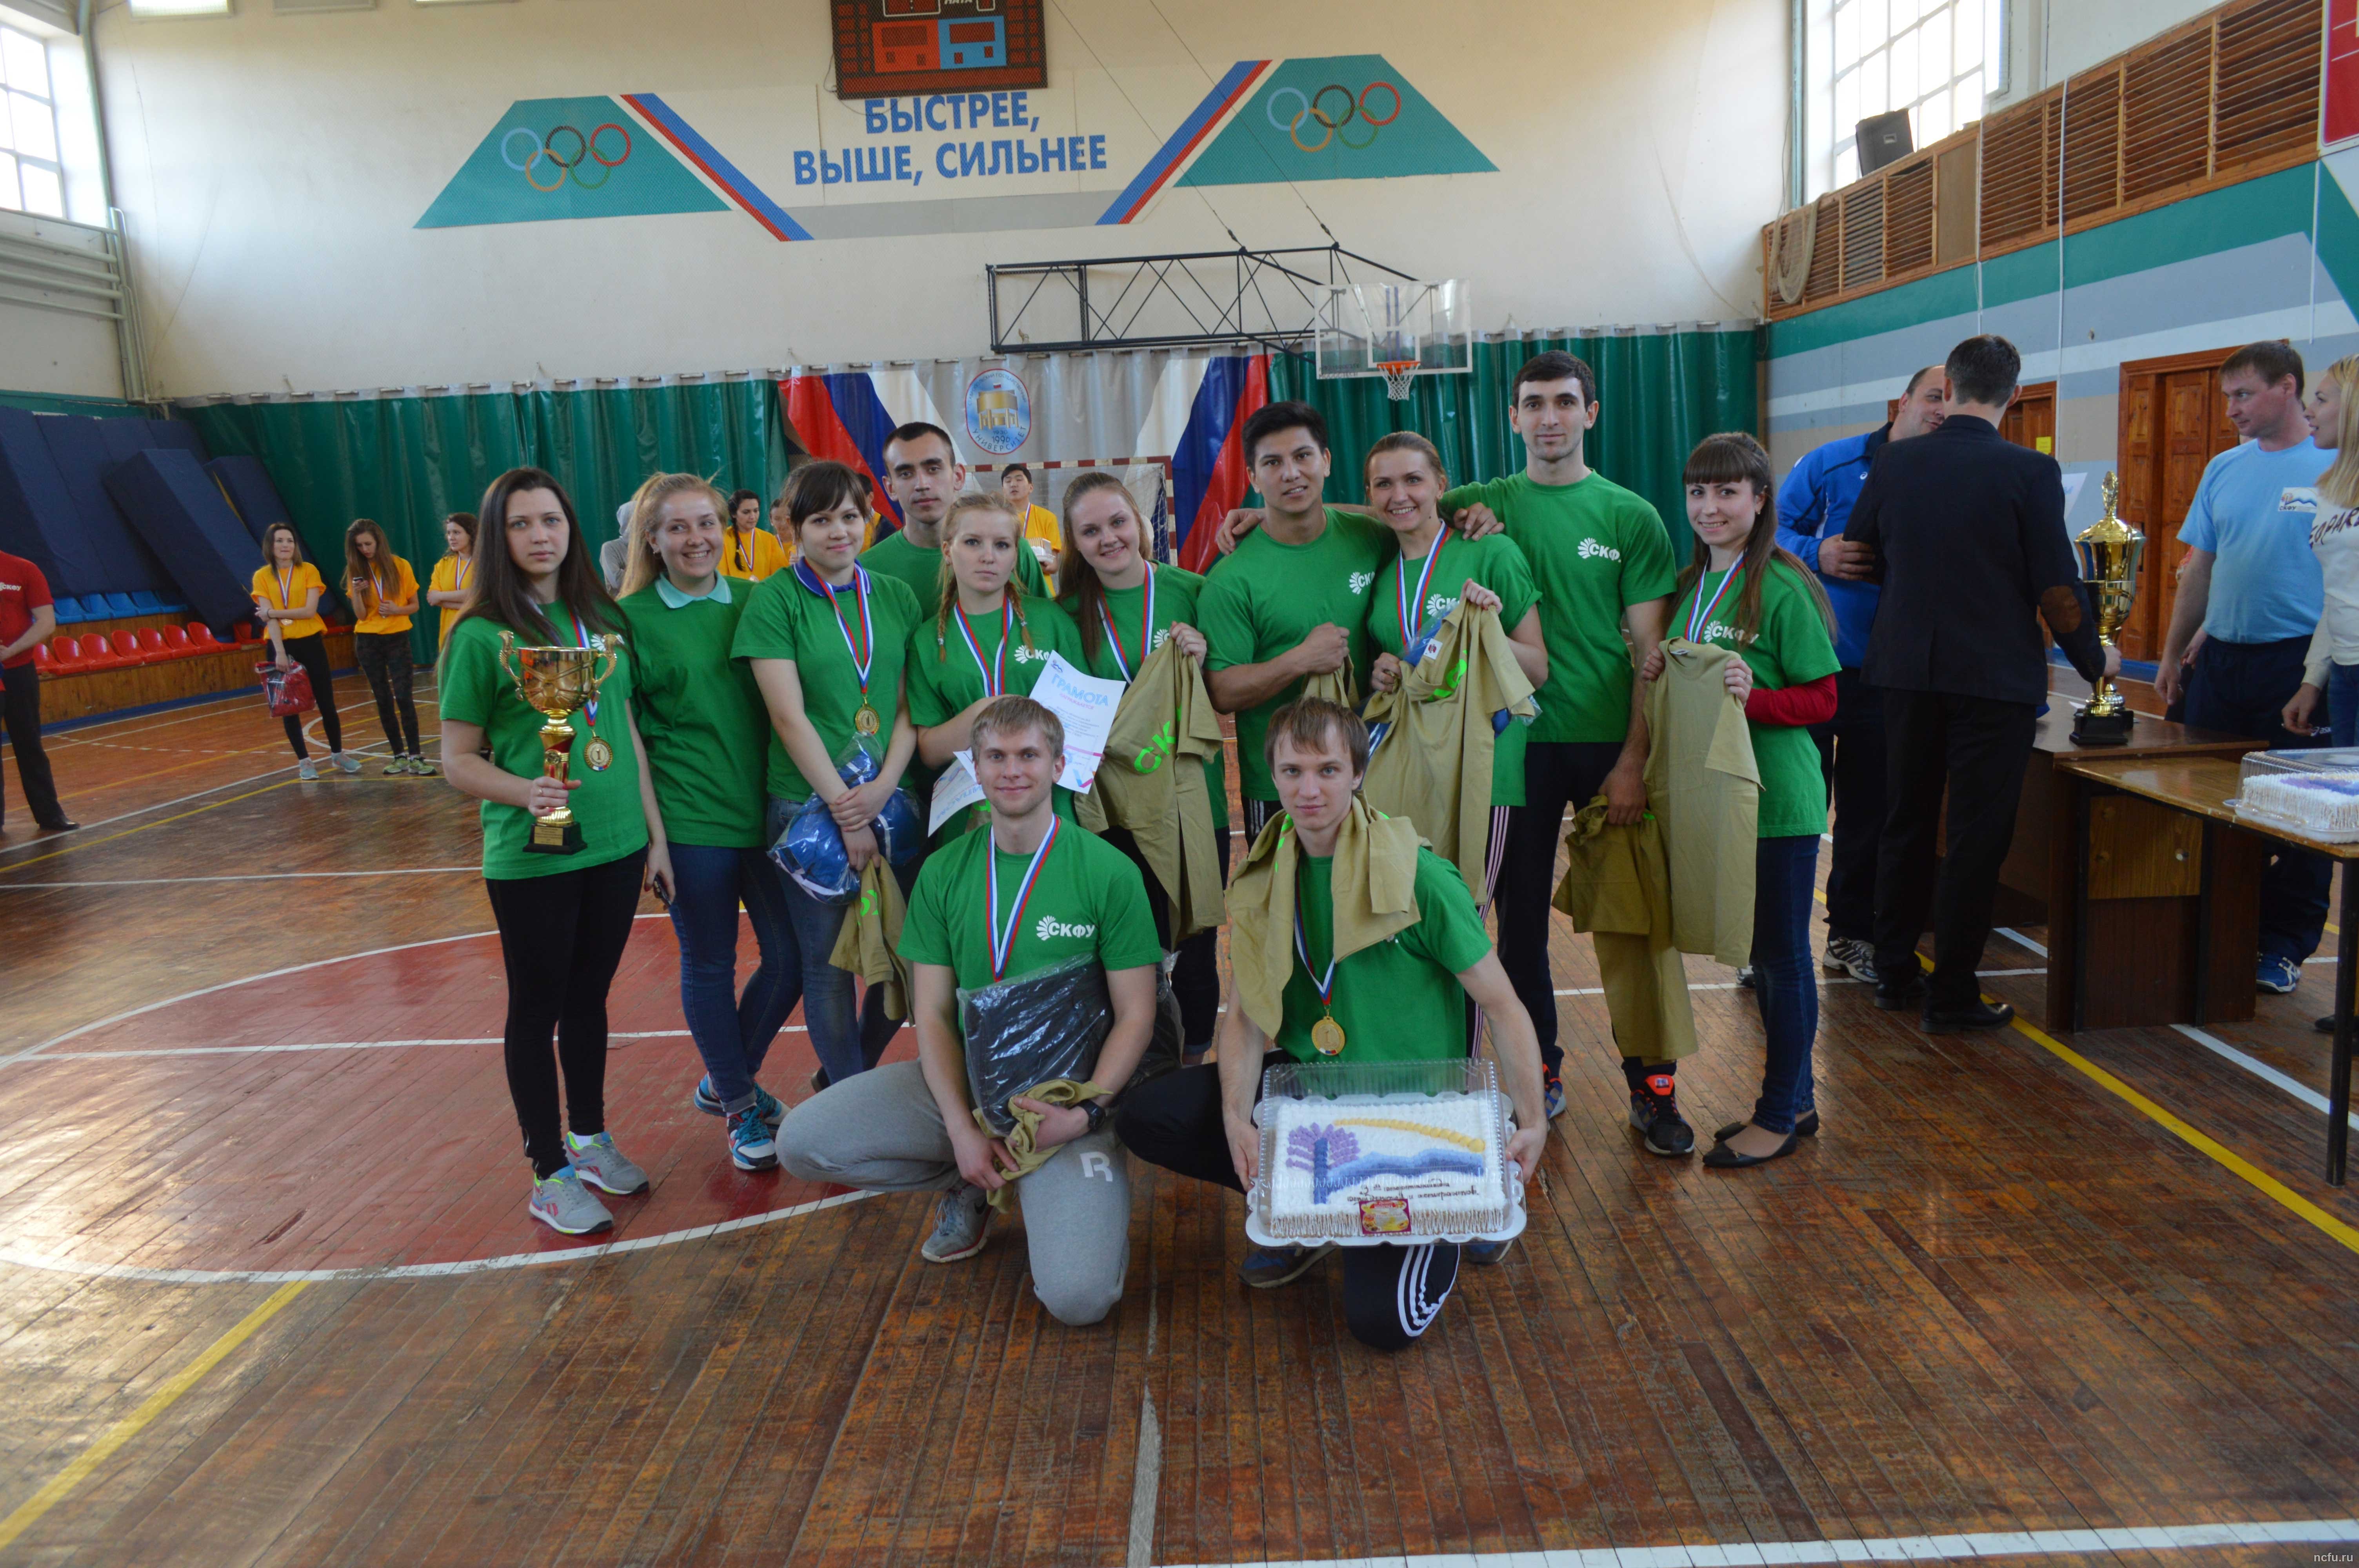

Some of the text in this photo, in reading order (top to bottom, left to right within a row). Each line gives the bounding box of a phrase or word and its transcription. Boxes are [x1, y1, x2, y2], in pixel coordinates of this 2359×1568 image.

[864, 91, 1040, 134] БЫСТРЕЕ,
[794, 135, 1107, 186] ВЫШЕ, СИЛЬНЕЕ
[972, 426, 1026, 452] УНИВЕРСИТЕТ
[1589, 543, 1622, 563] СКФ
[1051, 673, 1108, 706] ГРАМОТА
[1134, 703, 1182, 774] СК
[1048, 922, 1095, 938] СКФУ
